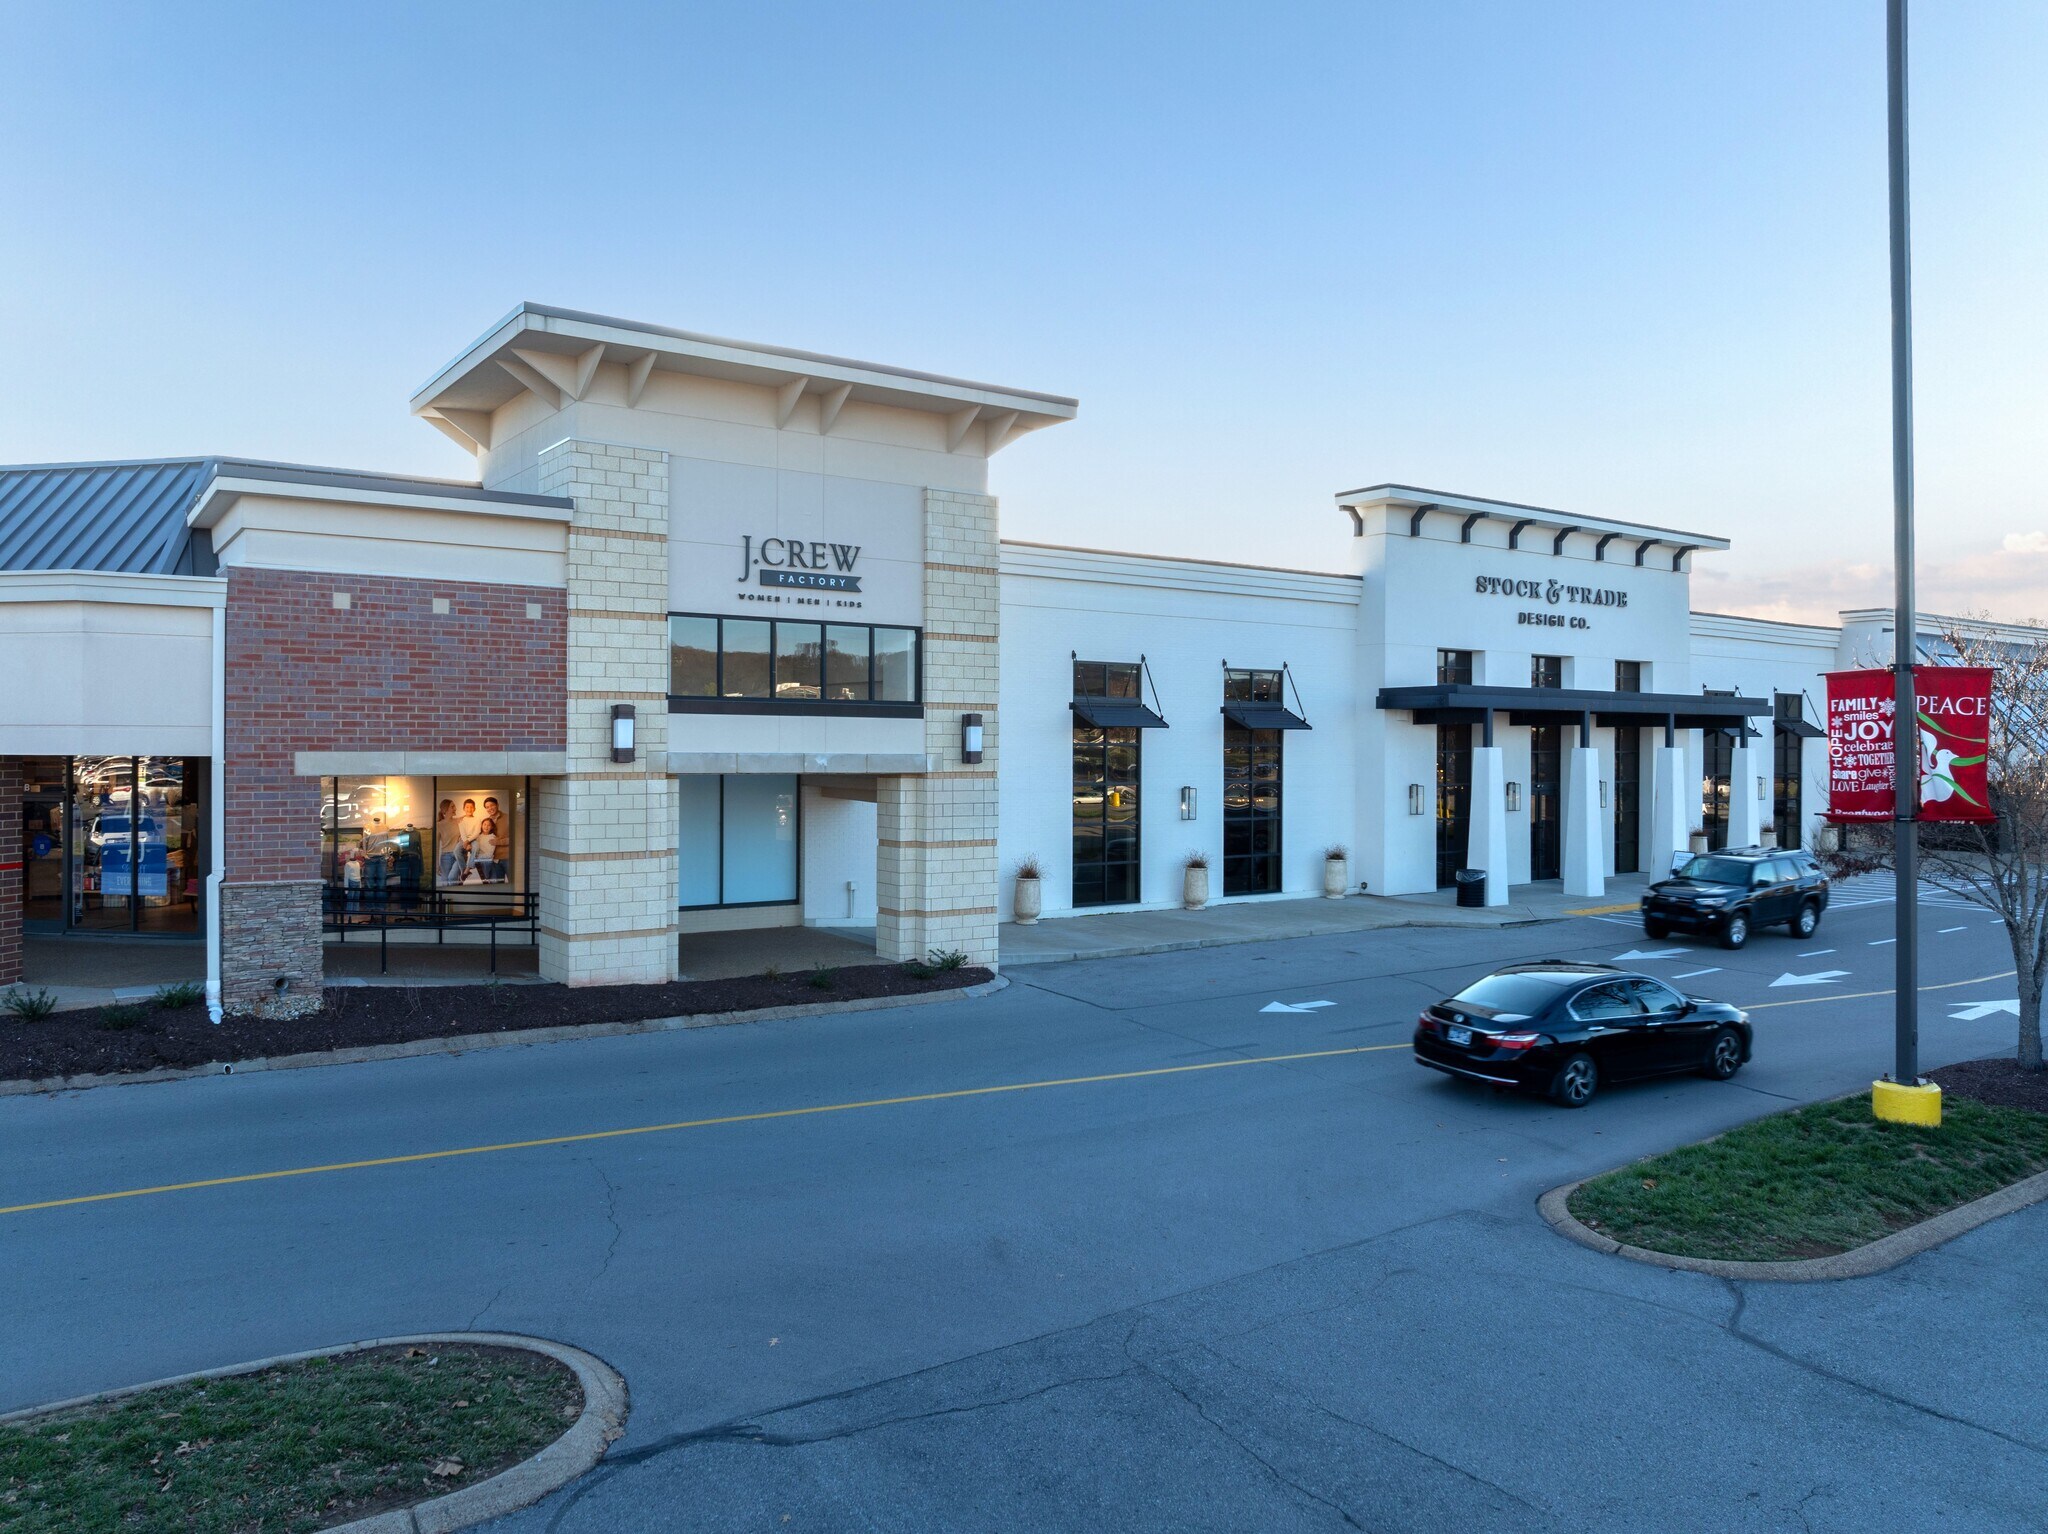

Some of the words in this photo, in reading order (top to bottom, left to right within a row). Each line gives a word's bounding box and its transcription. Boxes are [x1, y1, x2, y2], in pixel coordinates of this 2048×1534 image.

[738, 535, 861, 582] J.CREW
[779, 575, 846, 587] FACTORY
[1476, 576, 1542, 599] STOCK
[1546, 579, 1564, 604] &
[1567, 585, 1628, 607] TRADE
[738, 593, 780, 602] WOMEN
[837, 600, 862, 608] KIDS
[1518, 612, 1565, 627] DESIGN
[1570, 616, 1590, 629] CO.
[1831, 697, 1878, 712] FAMILY
[1916, 695, 1987, 716] PEACE
[1843, 711, 1879, 721] smiles
[1844, 720, 1894, 741] JOY
[1830, 729, 1843, 768] HOPE
[1844, 741, 1893, 753] celebrae
[1858, 767, 1882, 781] give
[1831, 781, 1860, 792] LOVE
[116, 876, 152, 886] EVERHING
